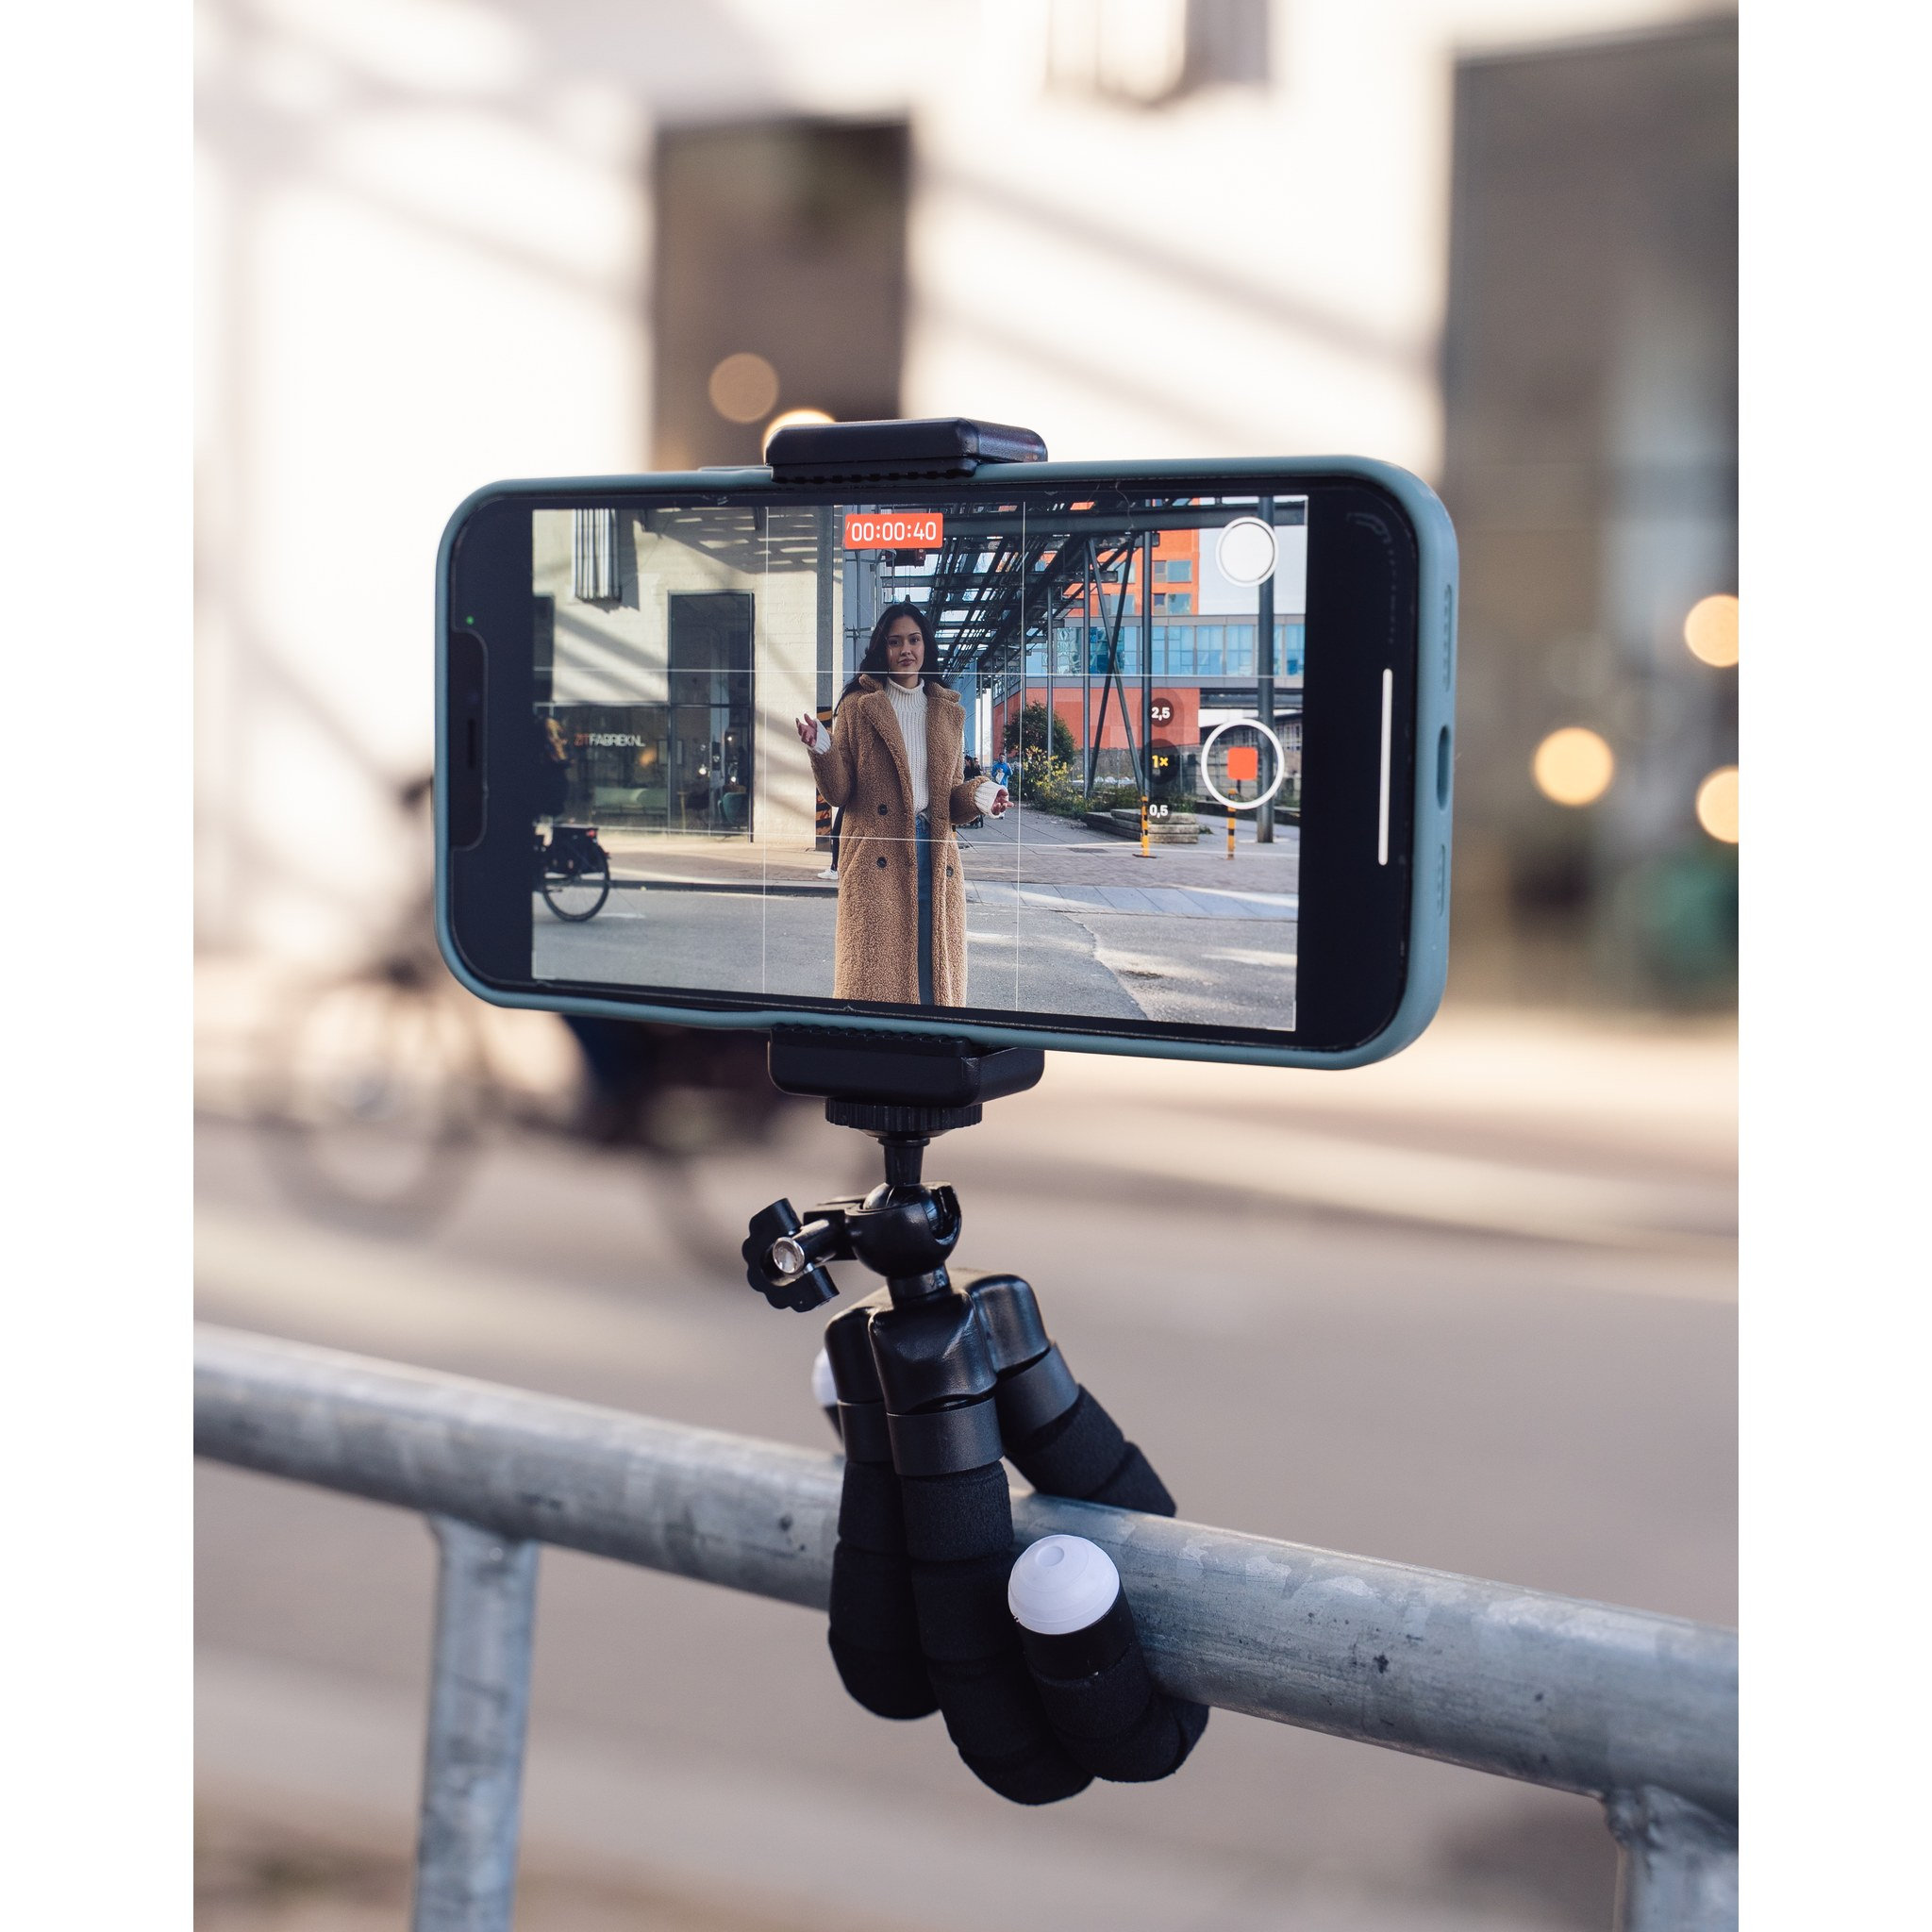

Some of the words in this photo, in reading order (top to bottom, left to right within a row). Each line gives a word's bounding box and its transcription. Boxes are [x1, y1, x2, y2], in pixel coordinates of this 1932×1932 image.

[851, 522, 937, 541] 00:00:40
[1151, 707, 1171, 721] 2,5
[1149, 805, 1169, 818] 0,5
